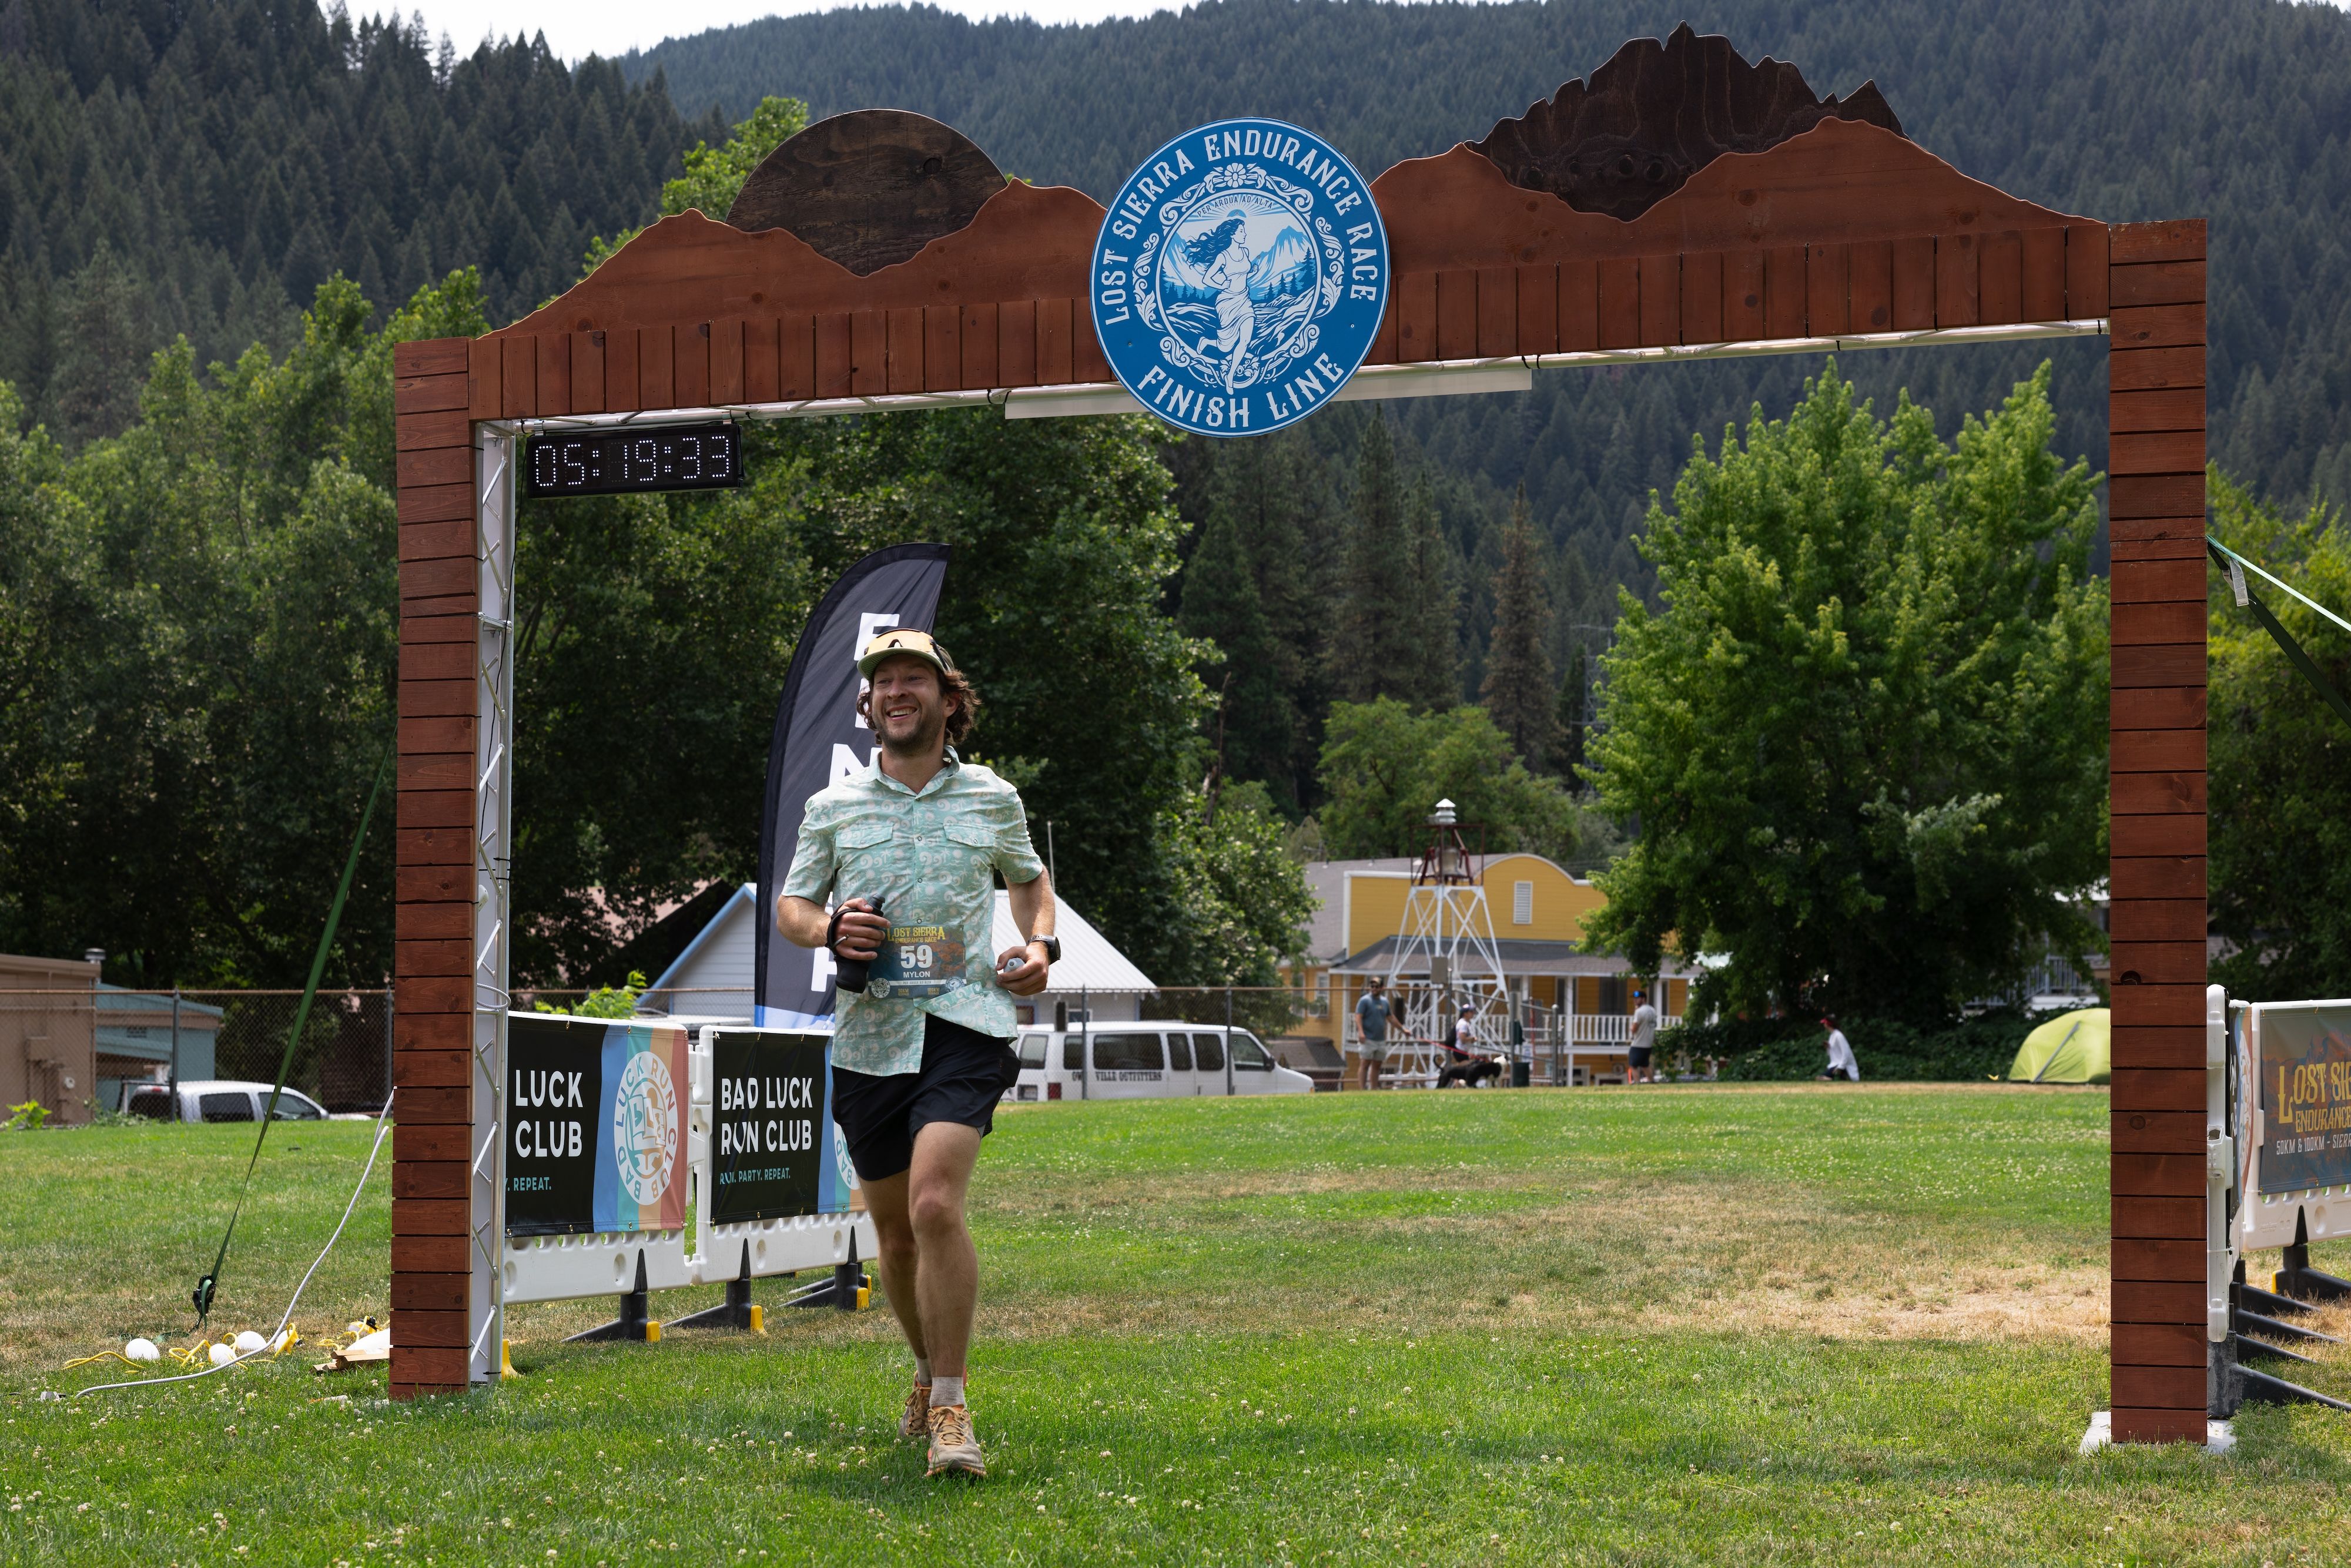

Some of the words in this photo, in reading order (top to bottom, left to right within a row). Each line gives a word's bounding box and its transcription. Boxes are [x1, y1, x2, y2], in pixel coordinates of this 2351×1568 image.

[1113, 149, 1195, 240] SIERRA
[1204, 129, 1362, 216] ENDURANCE
[1197, 205, 1211, 217] PER
[1214, 196, 1238, 208] ARDUA
[1254, 196, 1273, 209] ALTA
[1347, 222, 1379, 301] RACE
[1101, 249, 1130, 326] LOST
[1137, 364, 1250, 428] FINISH
[1266, 352, 1344, 421] LINE
[535, 435, 729, 487] 05:19:33
[887, 927, 910, 941] LOST
[913, 926, 945, 940] SIERRA
[900, 944, 933, 969] 59
[515, 1070, 583, 1108] LUCK
[616, 1056, 644, 1128] LUCK
[651, 1057, 675, 1111] RUN
[721, 1077, 759, 1110] BAD
[766, 1077, 813, 1108] LUCK
[1095, 1071, 1117, 1081] VILLE
[2278, 1063, 2326, 1124] LOST
[515, 1121, 582, 1158] CLUB
[721, 1121, 759, 1155] RUN
[766, 1120, 812, 1152] CLUB
[2276, 1138, 2295, 1155] 50KM
[2298, 1138, 2302, 1152] &
[2304, 1135, 2325, 1152] 100KM
[514, 1177, 551, 1191] REPEAT.
[618, 1146, 642, 1200] BAD
[651, 1128, 676, 1198] CLUB
[738, 1169, 762, 1182] PARTY.
[764, 1167, 791, 1181] REPEAT.
[836, 1139, 852, 1185] BAD
